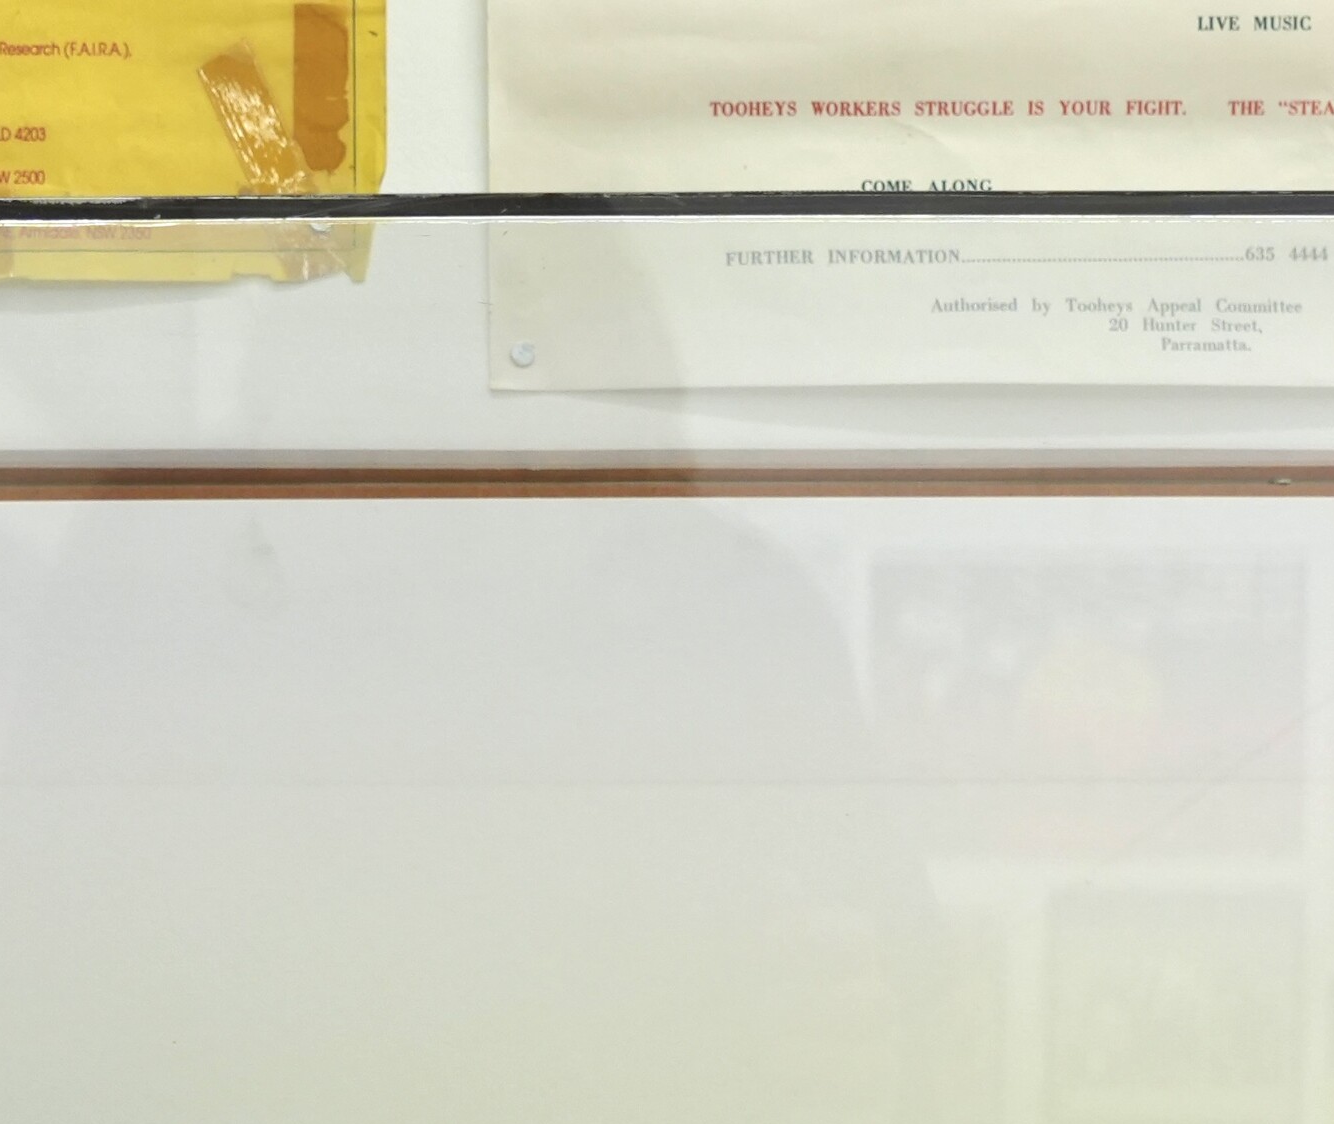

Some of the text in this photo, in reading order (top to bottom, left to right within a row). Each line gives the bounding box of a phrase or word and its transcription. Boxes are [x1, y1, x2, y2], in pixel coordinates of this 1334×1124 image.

[1197, 15, 1312, 32] LIVE MUSIC
[0, 41, 61, 56] Research
[709, 101, 798, 118] TOOHEYS
[811, 101, 902, 117] WORKERS
[914, 101, 1014, 117] STRUGGLE
[1027, 101, 1044, 117] IS
[1059, 101, 1112, 117] YOUR
[1125, 101, 1187, 117] FIGHT.
[1228, 101, 1265, 116] THE
[860, 179, 993, 191] COME ALONG
[725, 249, 814, 266] FURTHER
[1288, 246, 1329, 261] 4444
[931, 297, 1303, 316] Authorised by Tooheys Appeal Committee
[1108, 317, 1129, 332] 20
[1142, 317, 1197, 332] Hunter
[1160, 337, 1253, 353] Parramatta.
